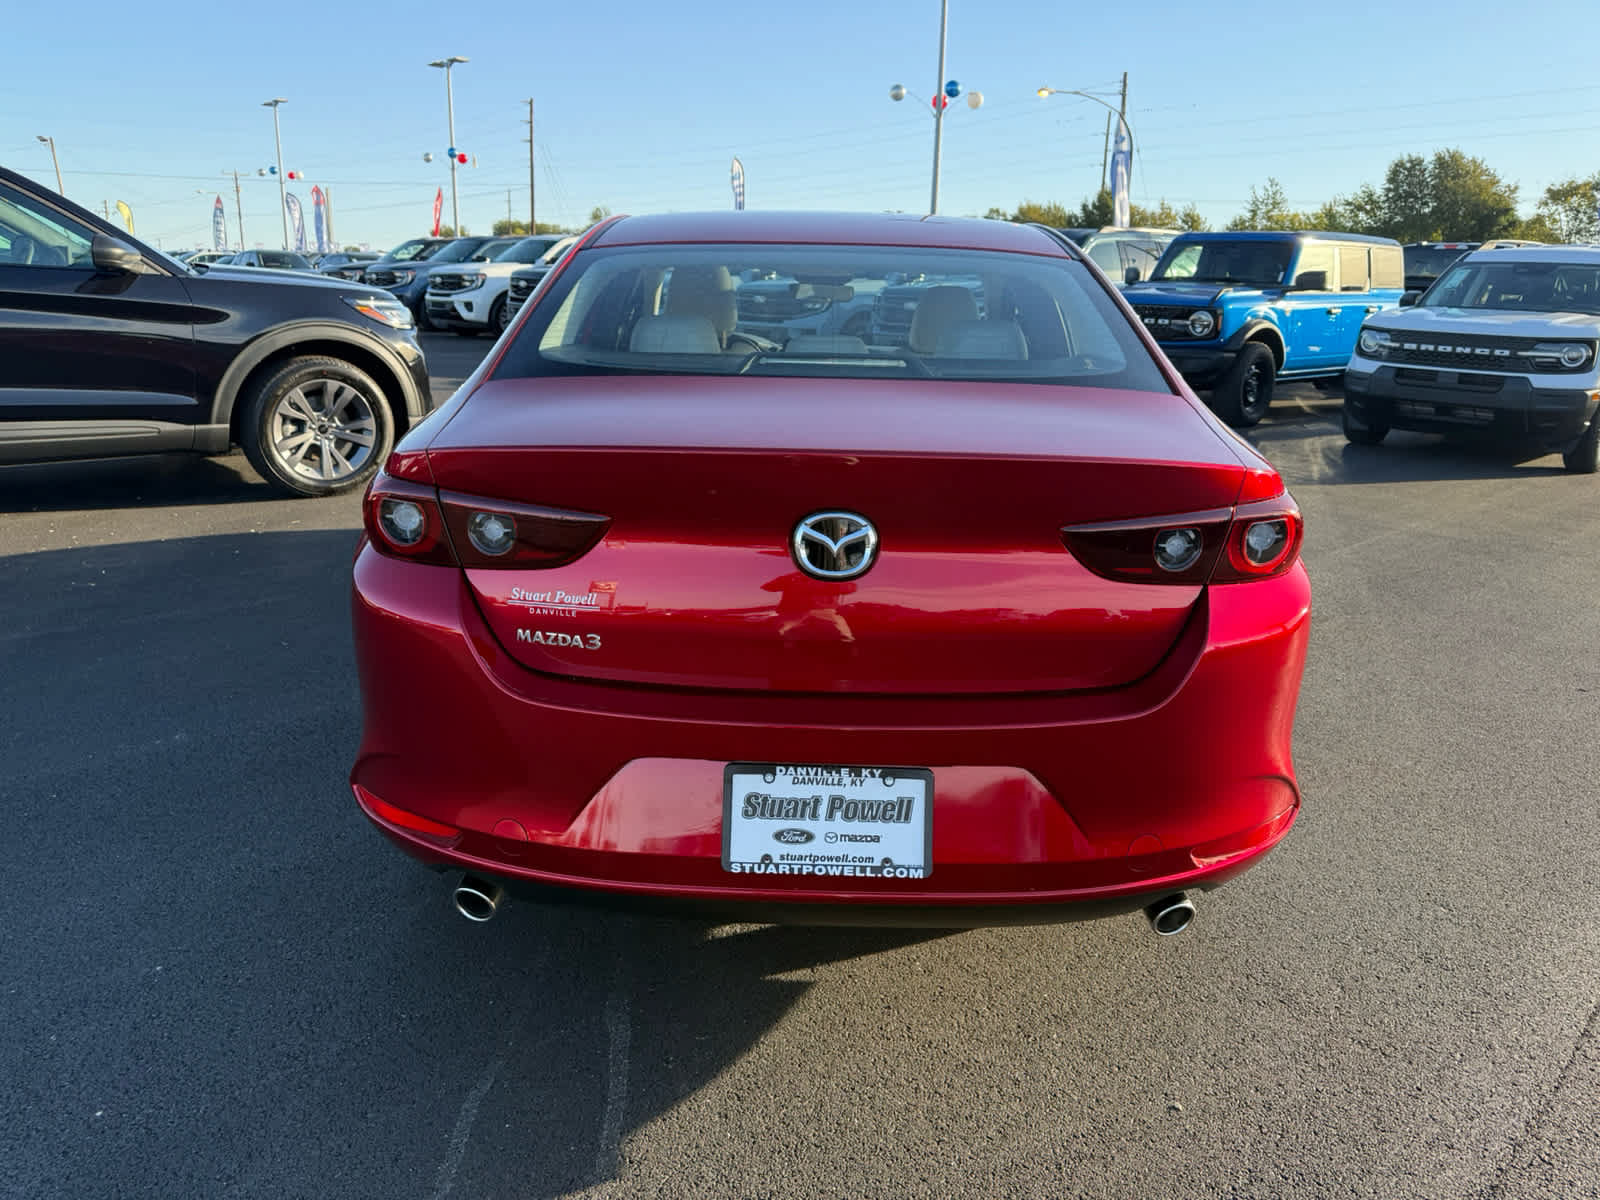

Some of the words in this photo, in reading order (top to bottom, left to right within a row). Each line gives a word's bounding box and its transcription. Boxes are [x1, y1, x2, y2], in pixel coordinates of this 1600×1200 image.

[1403, 343, 1510, 356] BRONCO
[512, 587, 552, 602] Stuart
[555, 590, 598, 605] Powell
[529, 607, 576, 617] DANVILLE
[517, 628, 602, 650] MAZDA3
[775, 766, 855, 777] DANVILLE,
[861, 768, 882, 778] KY
[792, 776, 847, 788] DANVILLE,
[850, 777, 865, 787] KY
[742, 792, 822, 821] Stuart
[825, 795, 915, 824] Powell
[781, 830, 808, 842] Ford
[839, 833, 881, 843] mazda
[779, 853, 875, 864] stuartpowell.com
[730, 863, 924, 879] STUARTPOWELL.COM
